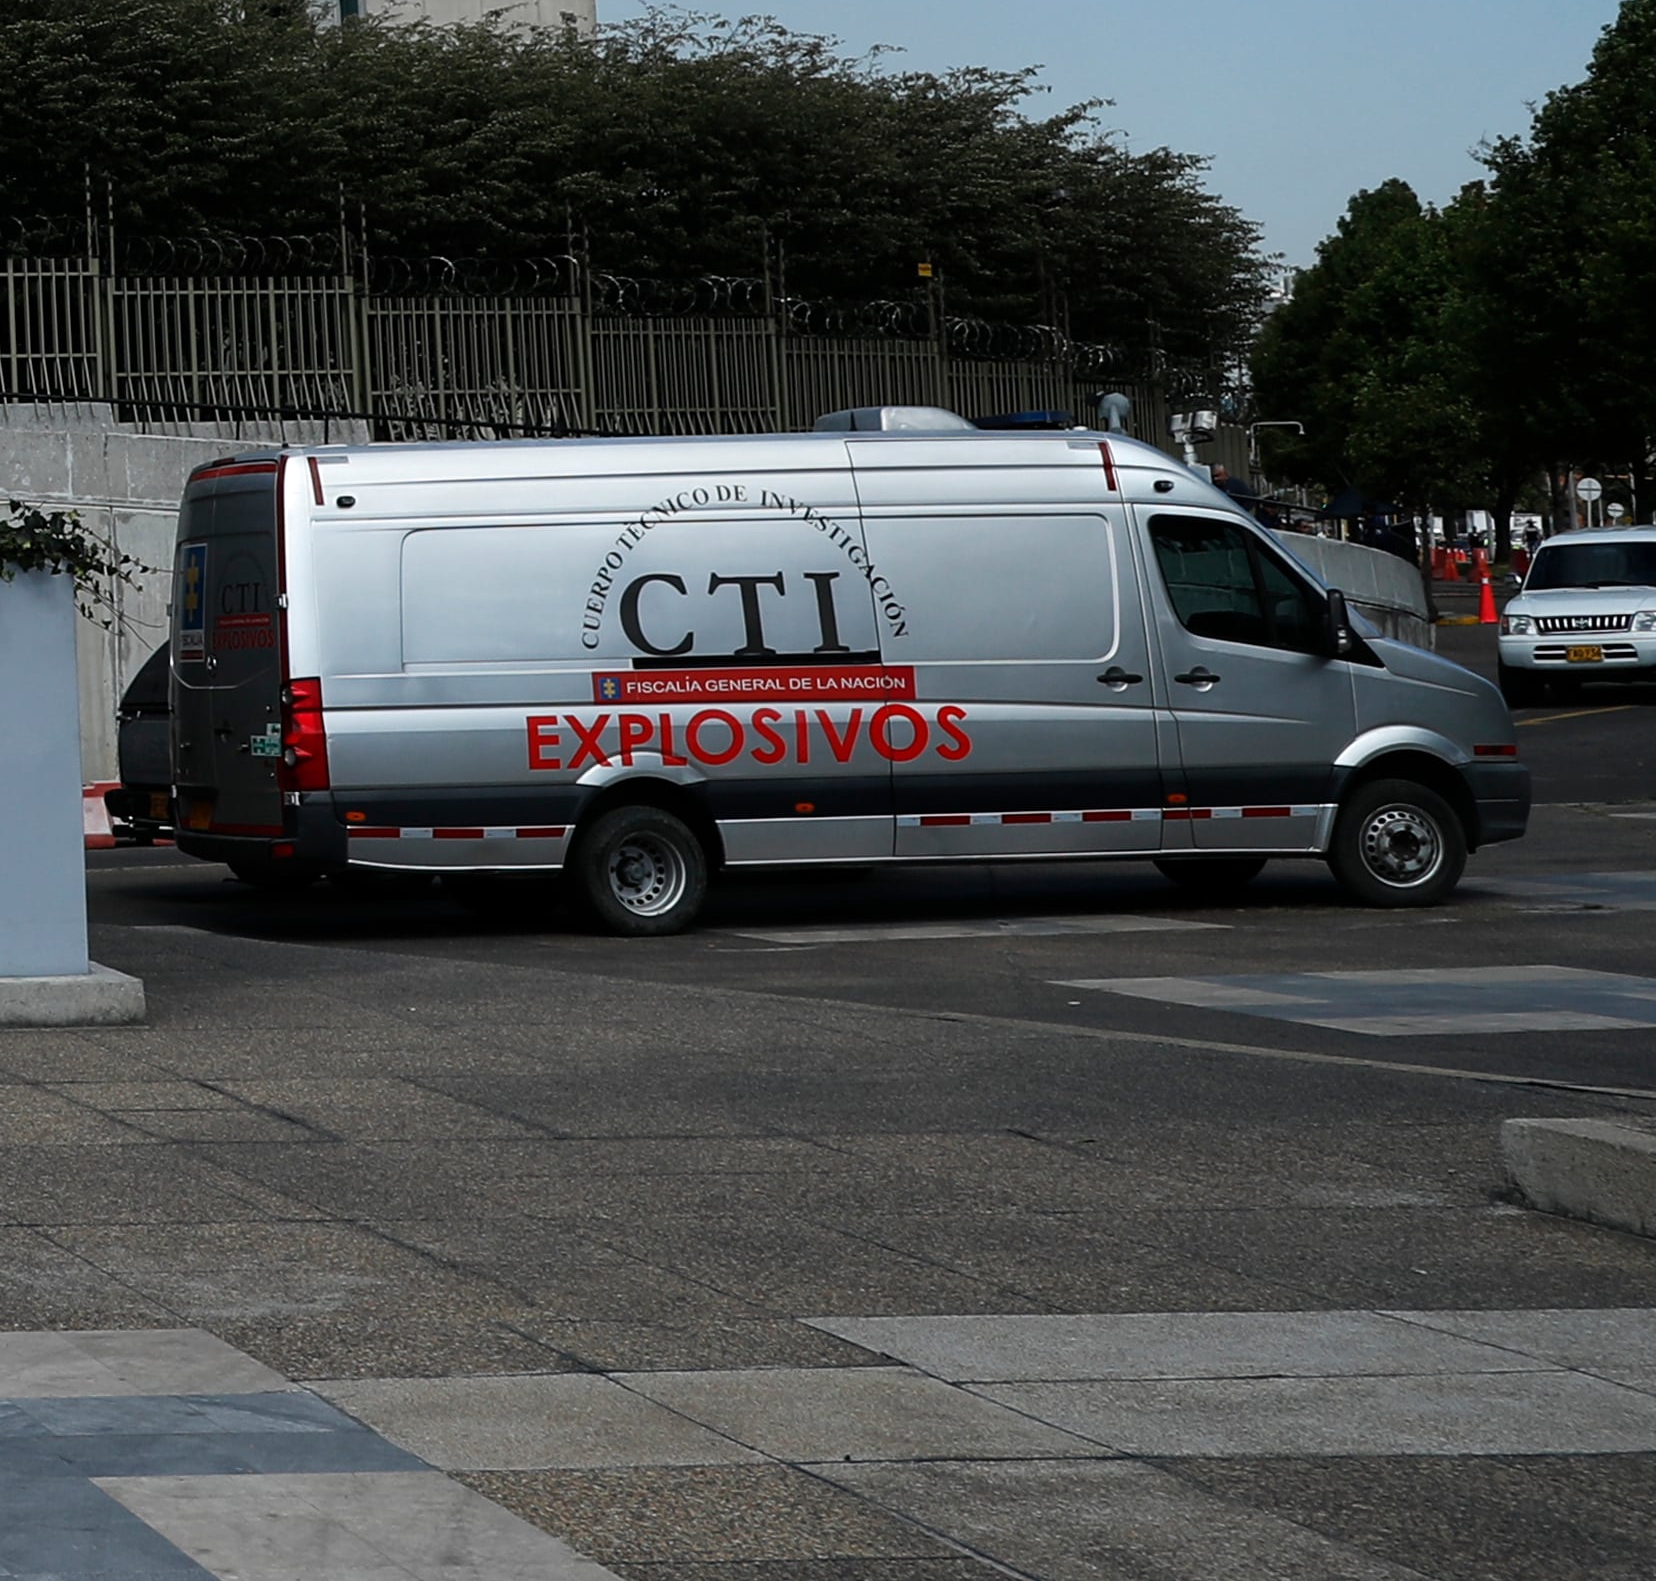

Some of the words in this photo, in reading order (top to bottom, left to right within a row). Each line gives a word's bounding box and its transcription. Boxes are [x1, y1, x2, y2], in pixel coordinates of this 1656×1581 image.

[222, 582, 260, 614] CTI
[581, 551, 623, 650] CUERPO
[715, 484, 748, 502] DE
[760, 489, 909, 638] INVESTIGACIÓN
[619, 571, 851, 657] CTI
[704, 677, 786, 693] GENERAL
[789, 677, 813, 691] DE
[816, 676, 838, 690] LA
[840, 674, 906, 690] NACIÓN
[525, 703, 973, 771] EXPLOSIVOS
